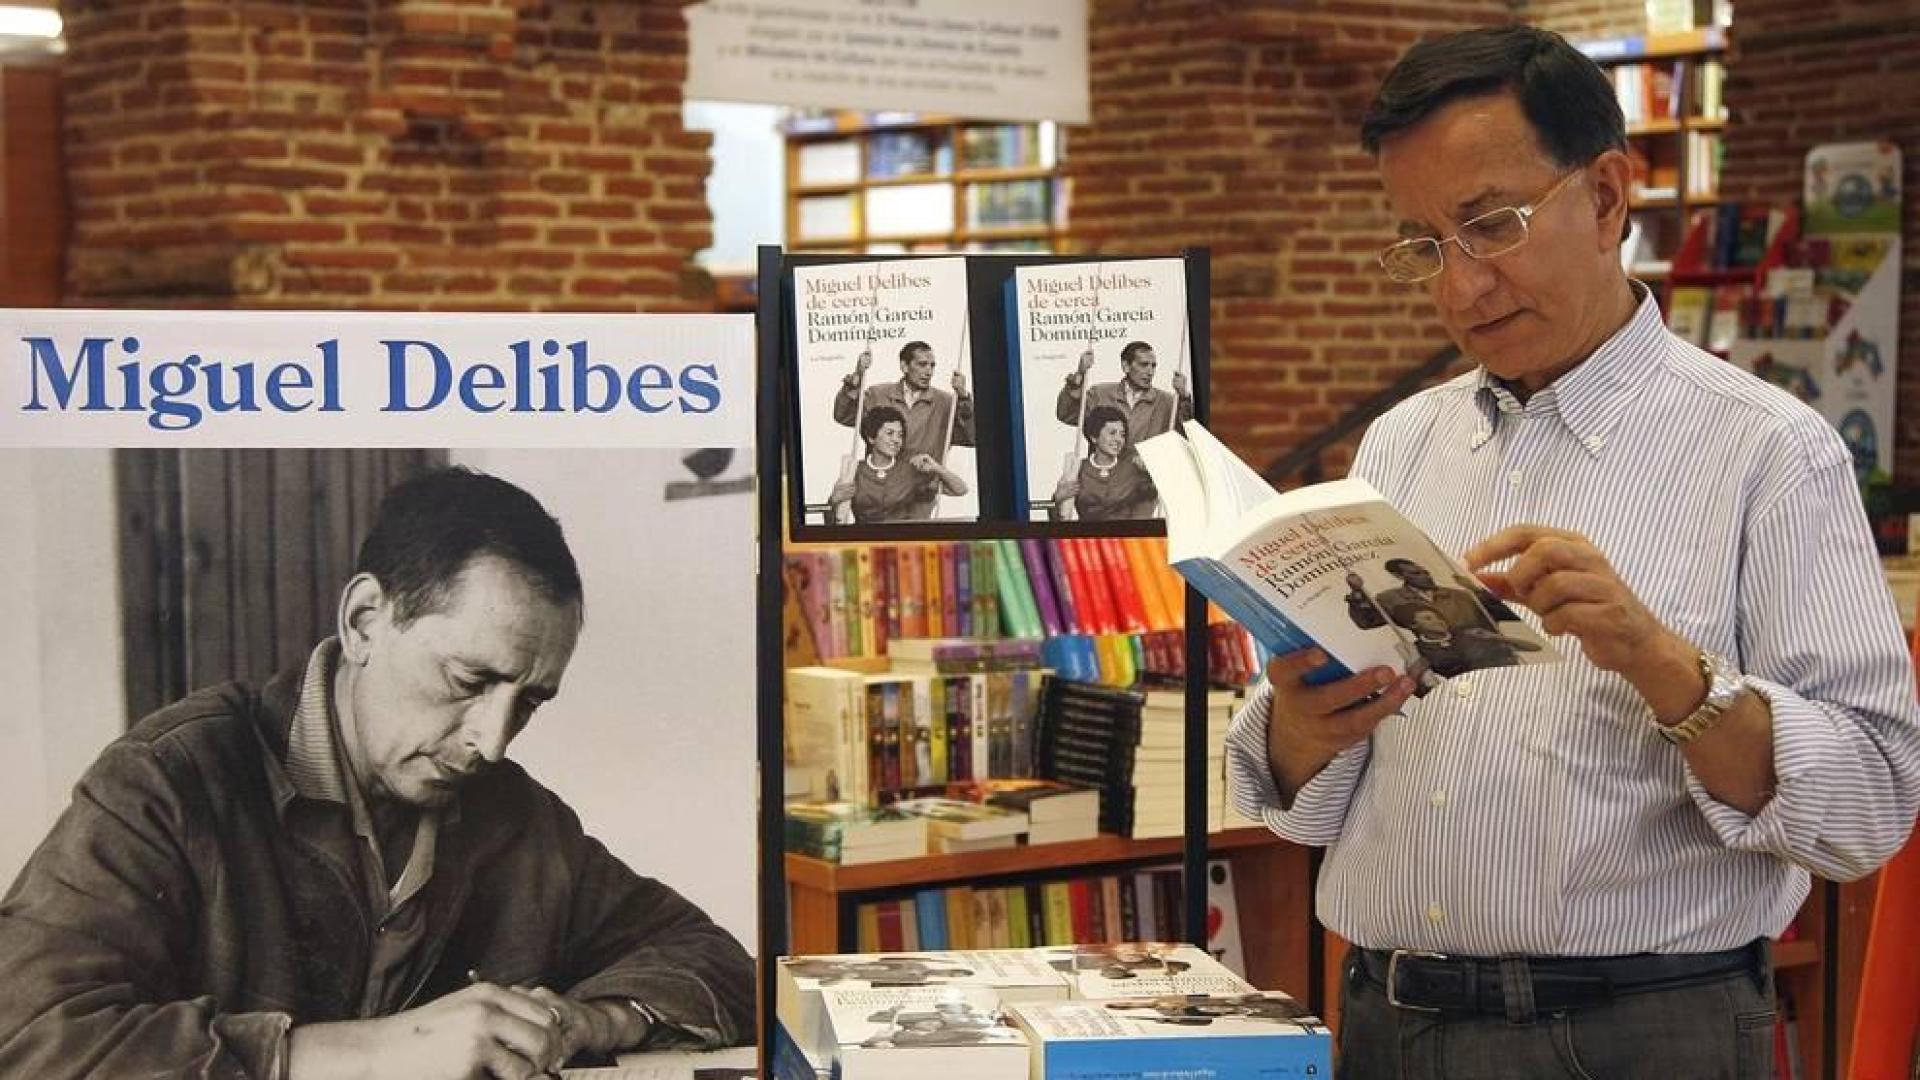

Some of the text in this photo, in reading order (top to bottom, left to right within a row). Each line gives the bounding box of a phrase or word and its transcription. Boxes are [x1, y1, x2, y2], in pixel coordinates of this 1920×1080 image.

[806, 272, 932, 296] Miguel Delibes
[1027, 272, 1152, 294] Miguel Delibes
[806, 294, 878, 310] de cerca
[1027, 294, 1100, 309] de cerca
[808, 305, 934, 326] Ramón García
[1029, 305, 1155, 326] Ramón García
[808, 325, 907, 343] Domínguez
[1030, 325, 1128, 342] Domínguez
[21, 336, 723, 432] Miguel Delibes
[1239, 528, 1303, 568] Miguel
[1256, 535, 1331, 579] de cerca
[1264, 534, 1397, 590] Ramón García
